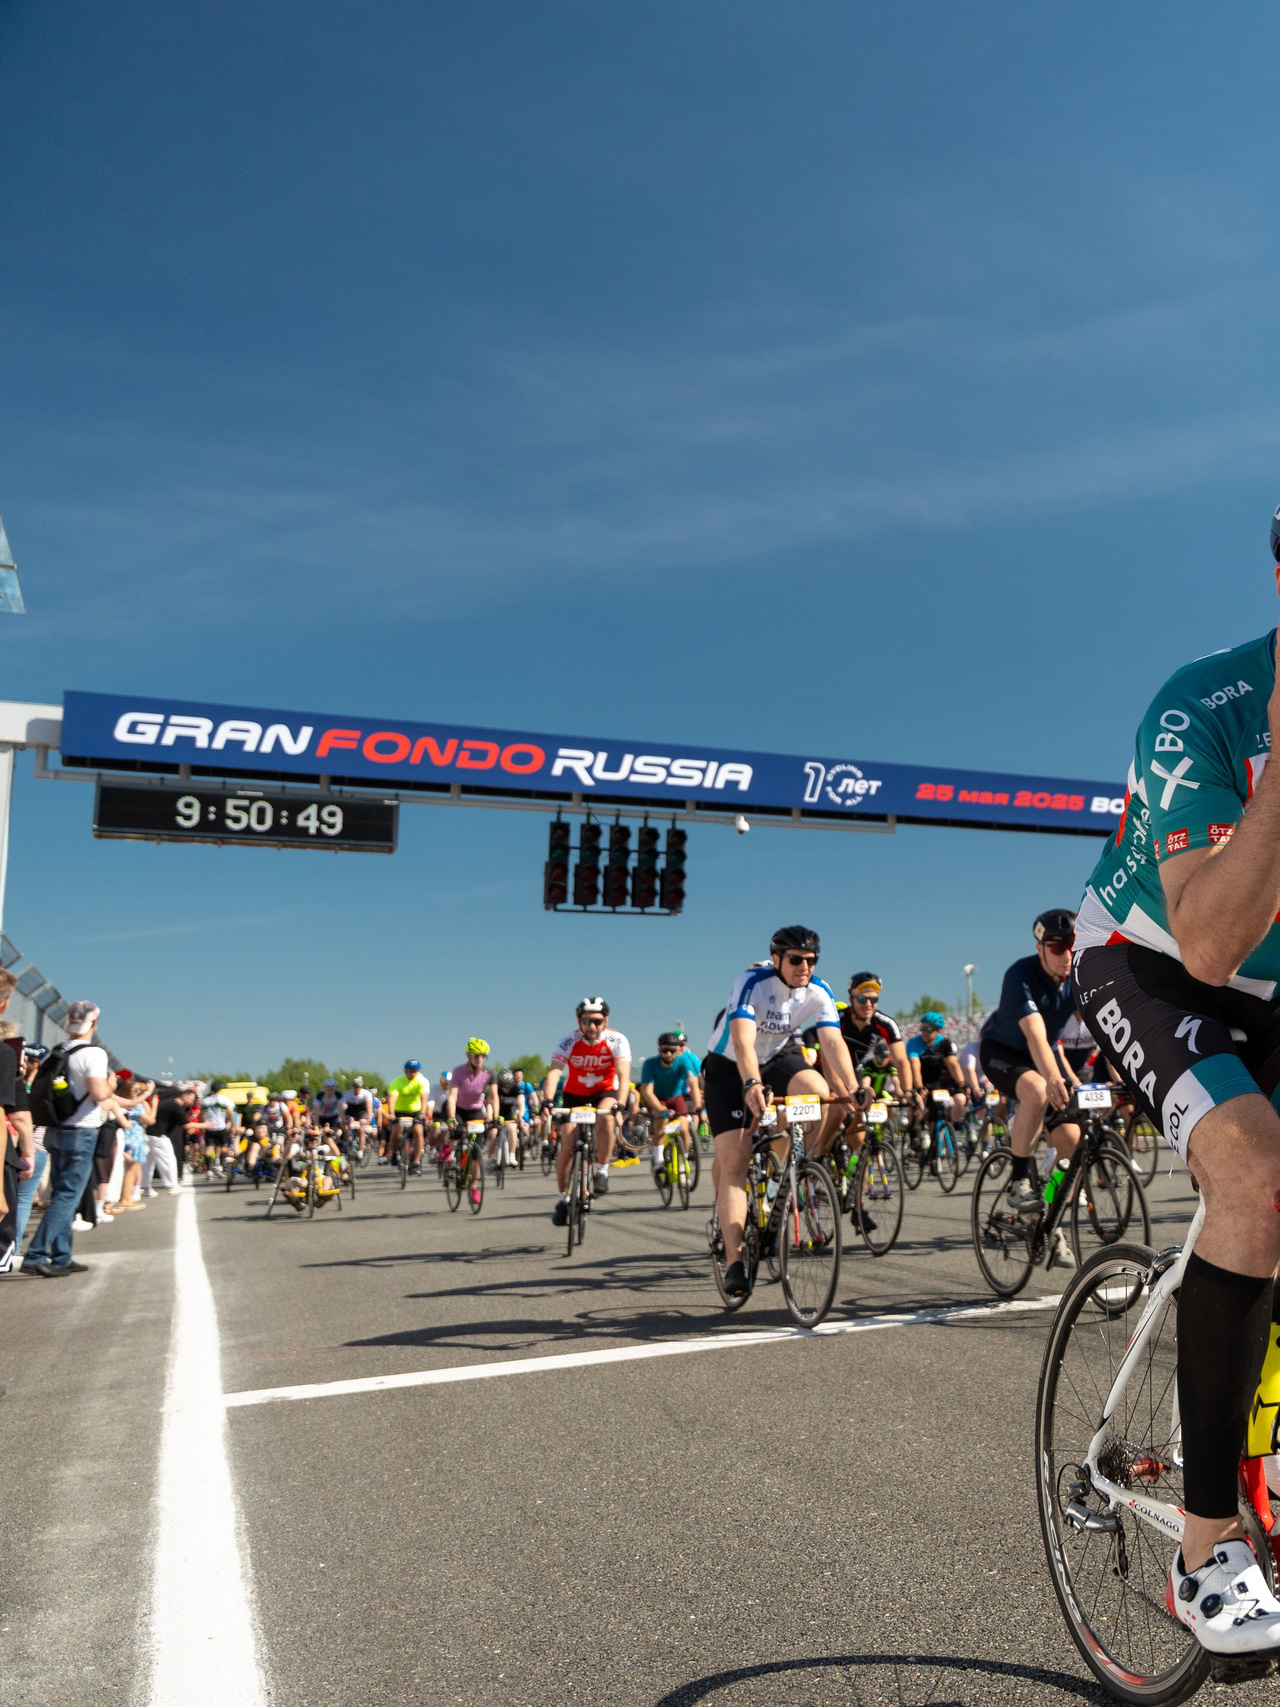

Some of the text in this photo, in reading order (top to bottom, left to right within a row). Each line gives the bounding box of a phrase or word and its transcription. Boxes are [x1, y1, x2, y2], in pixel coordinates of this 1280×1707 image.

[1200, 680, 1254, 710] BORA
[1154, 709, 1190, 752] BO
[113, 711, 754, 792] GRAN FONDO RUSSIA
[825, 786, 864, 807] FOR ALL
[837, 777, 882, 796] лет
[915, 782, 955, 801] 25
[958, 789, 1010, 806] мая
[1013, 790, 1086, 811] 2025
[1167, 832, 1187, 845] ÖTZ
[1210, 825, 1234, 835] ÖTZ
[1167, 841, 1188, 852] TAL
[765, 1009, 791, 1019] team
[569, 1054, 612, 1068] BMC
[1096, 998, 1157, 1108] BORA
[1084, 1091, 1105, 1102] 4138
[793, 1104, 816, 1116] 2207
[1170, 1102, 1190, 1141] COL
[1134, 1503, 1181, 1533] COLNAGO
